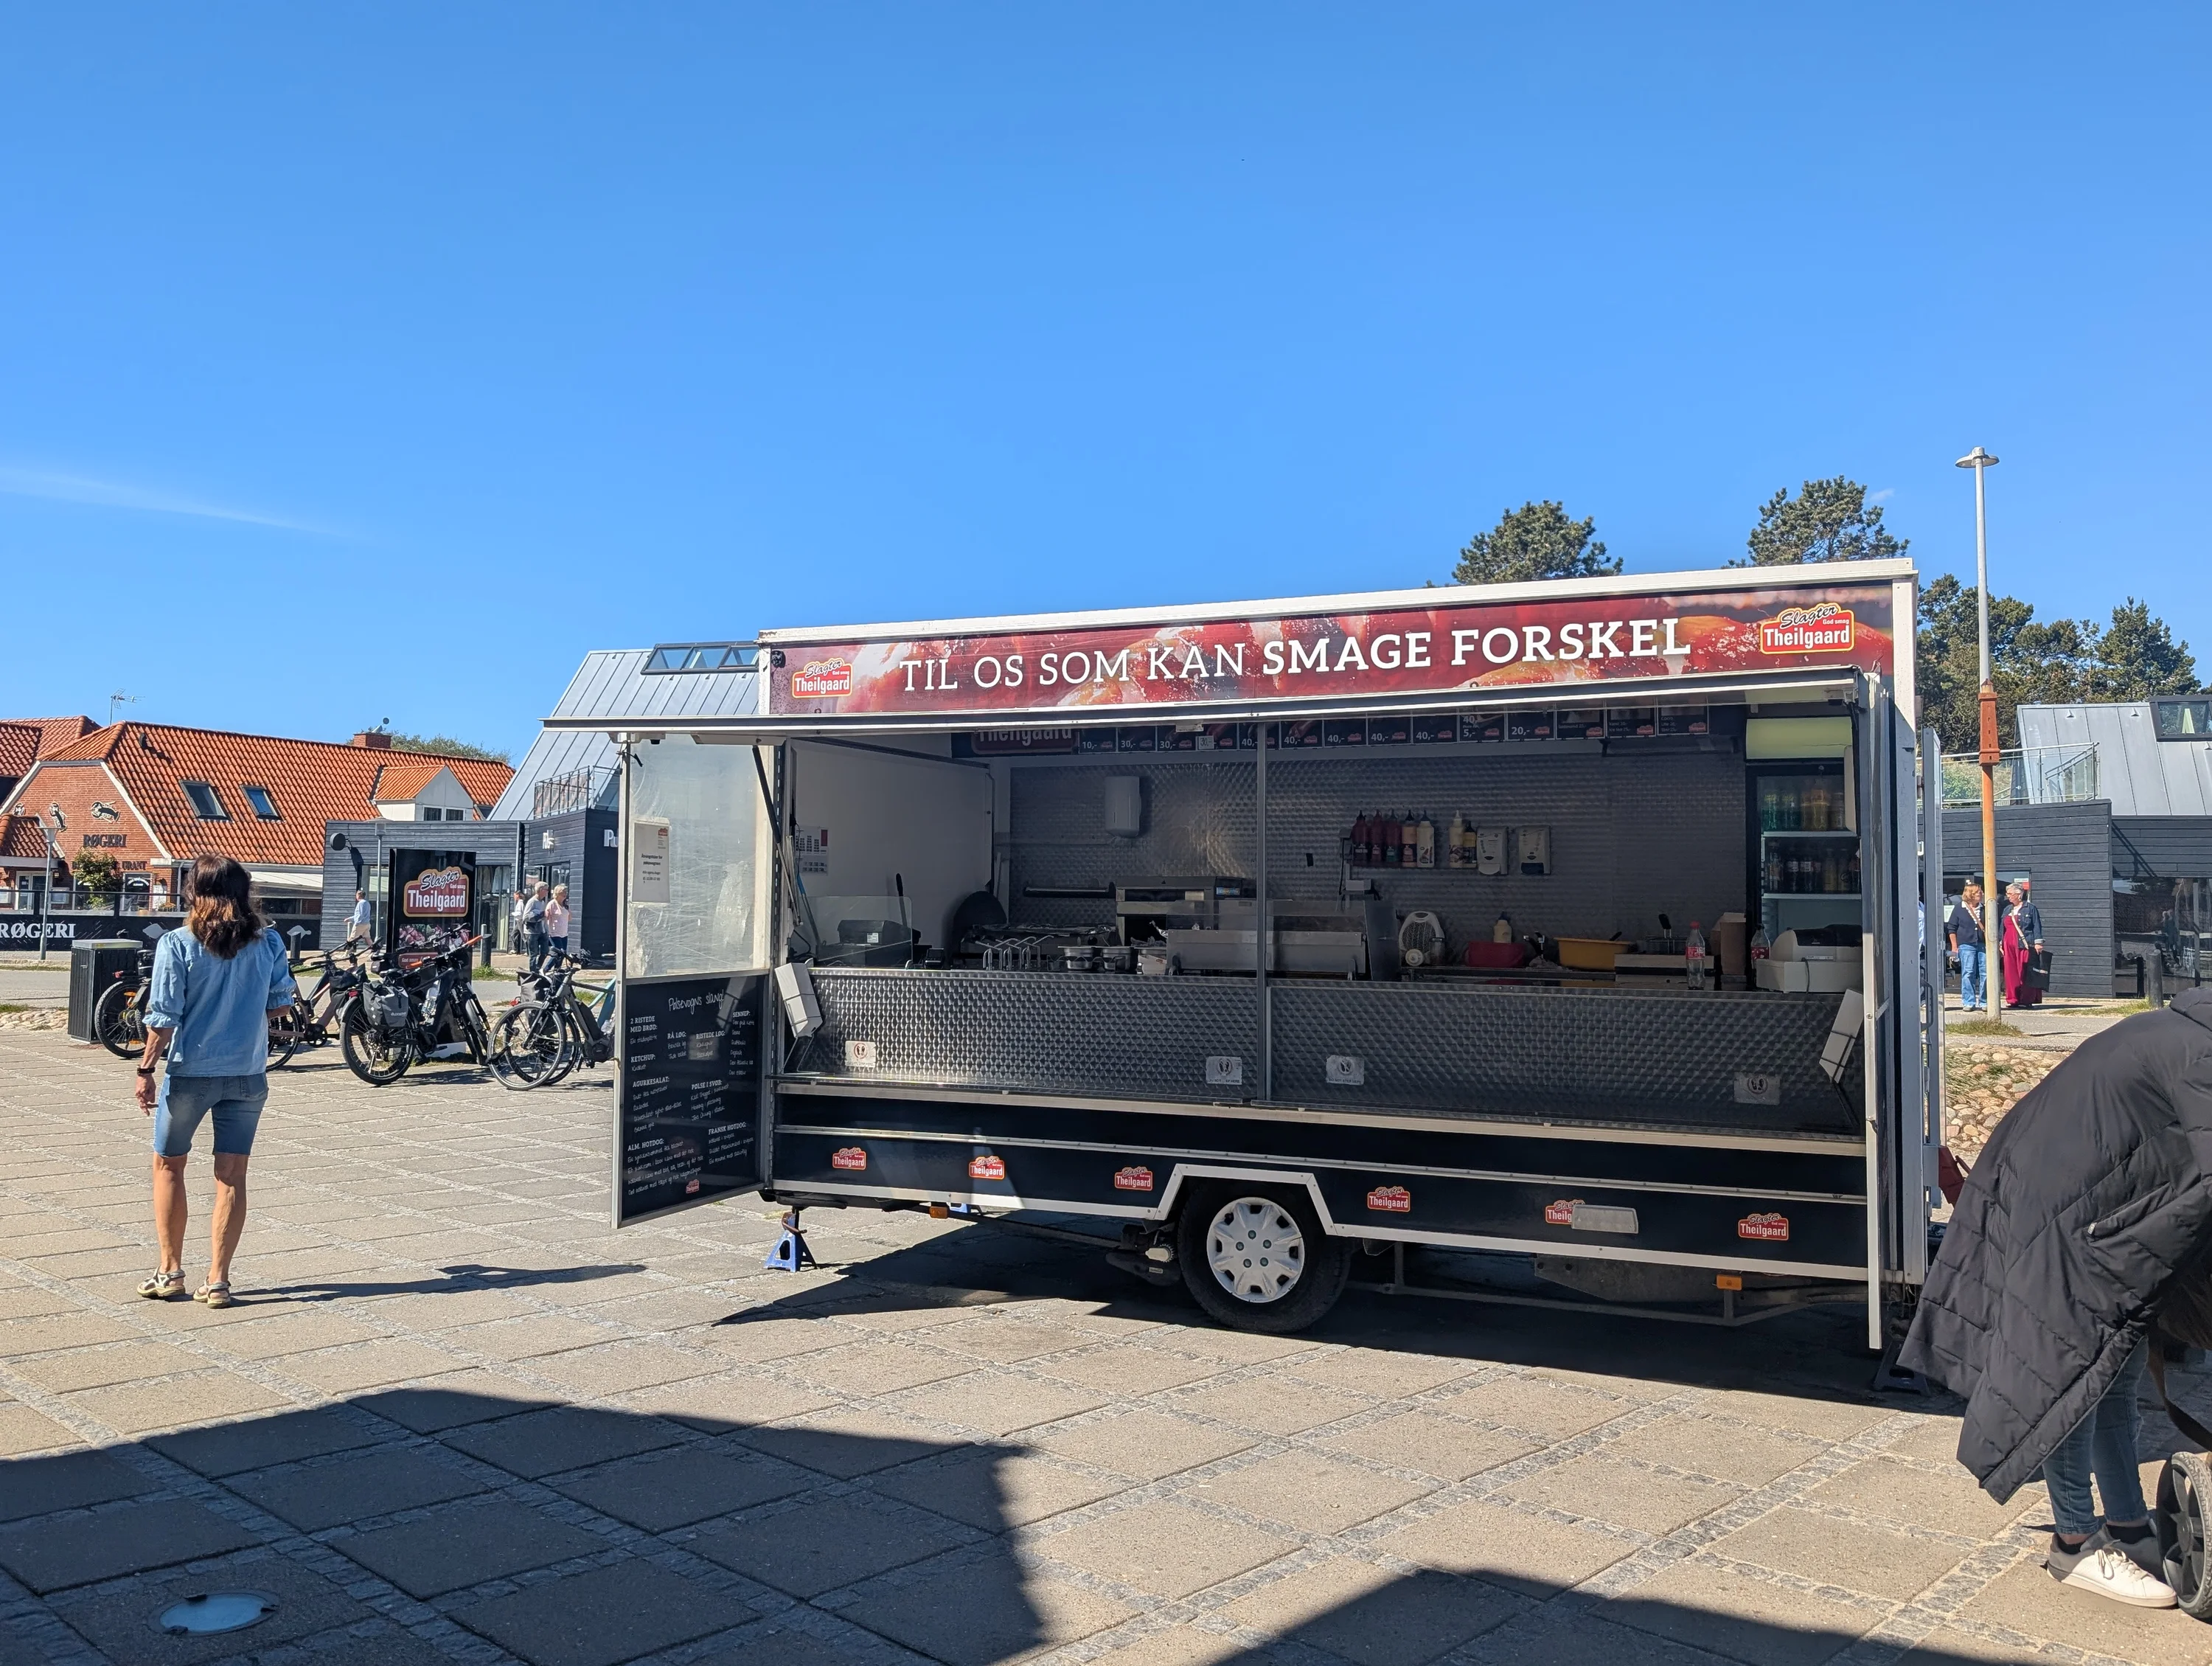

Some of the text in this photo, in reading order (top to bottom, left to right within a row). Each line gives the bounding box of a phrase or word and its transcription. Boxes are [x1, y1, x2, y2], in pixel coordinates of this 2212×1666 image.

[1780, 605, 1837, 628] Slagter
[1764, 625, 1850, 649] Theilgaard
[899, 617, 1691, 692] TIL OS SOM KAN SMAGE FORSKEL
[805, 660, 842, 678] Slagter
[795, 676, 849, 694] Theilgaard
[1416, 732, 1434, 740] 40,-
[1463, 729, 1475, 737] 5,-
[1512, 726, 1530, 736] 20,-
[1284, 736, 1301, 745] 40,-
[1327, 735, 1345, 743] 40,-
[1371, 733, 1388, 742] 40,-
[1082, 741, 1097, 749] 10,-
[1160, 740, 1175, 749] 30,-
[83, 834, 128, 847] RØGERI
[421, 870, 459, 891] Slagter
[408, 889, 465, 912] Theilgaard
[0, 922, 76, 938] RØGERI
[630, 1054, 655, 1063] KETCHUP:
[633, 1076, 669, 1087] AGURKESALAT:
[709, 1122, 746, 1135] FRANSK HOTDOG:
[627, 1138, 664, 1151] ALM. HOTDOG:
[834, 1156, 864, 1167] Theilgaard
[971, 1165, 1003, 1176] Theilgaard
[1116, 1176, 1151, 1187] Theilgaard
[1369, 1195, 1408, 1208] Theilgaard
[1555, 1201, 1584, 1211] Slag
[1548, 1209, 1572, 1222] Theilg
[1748, 1214, 1778, 1224] Slagter
[1741, 1224, 1786, 1237] Theilgaard
